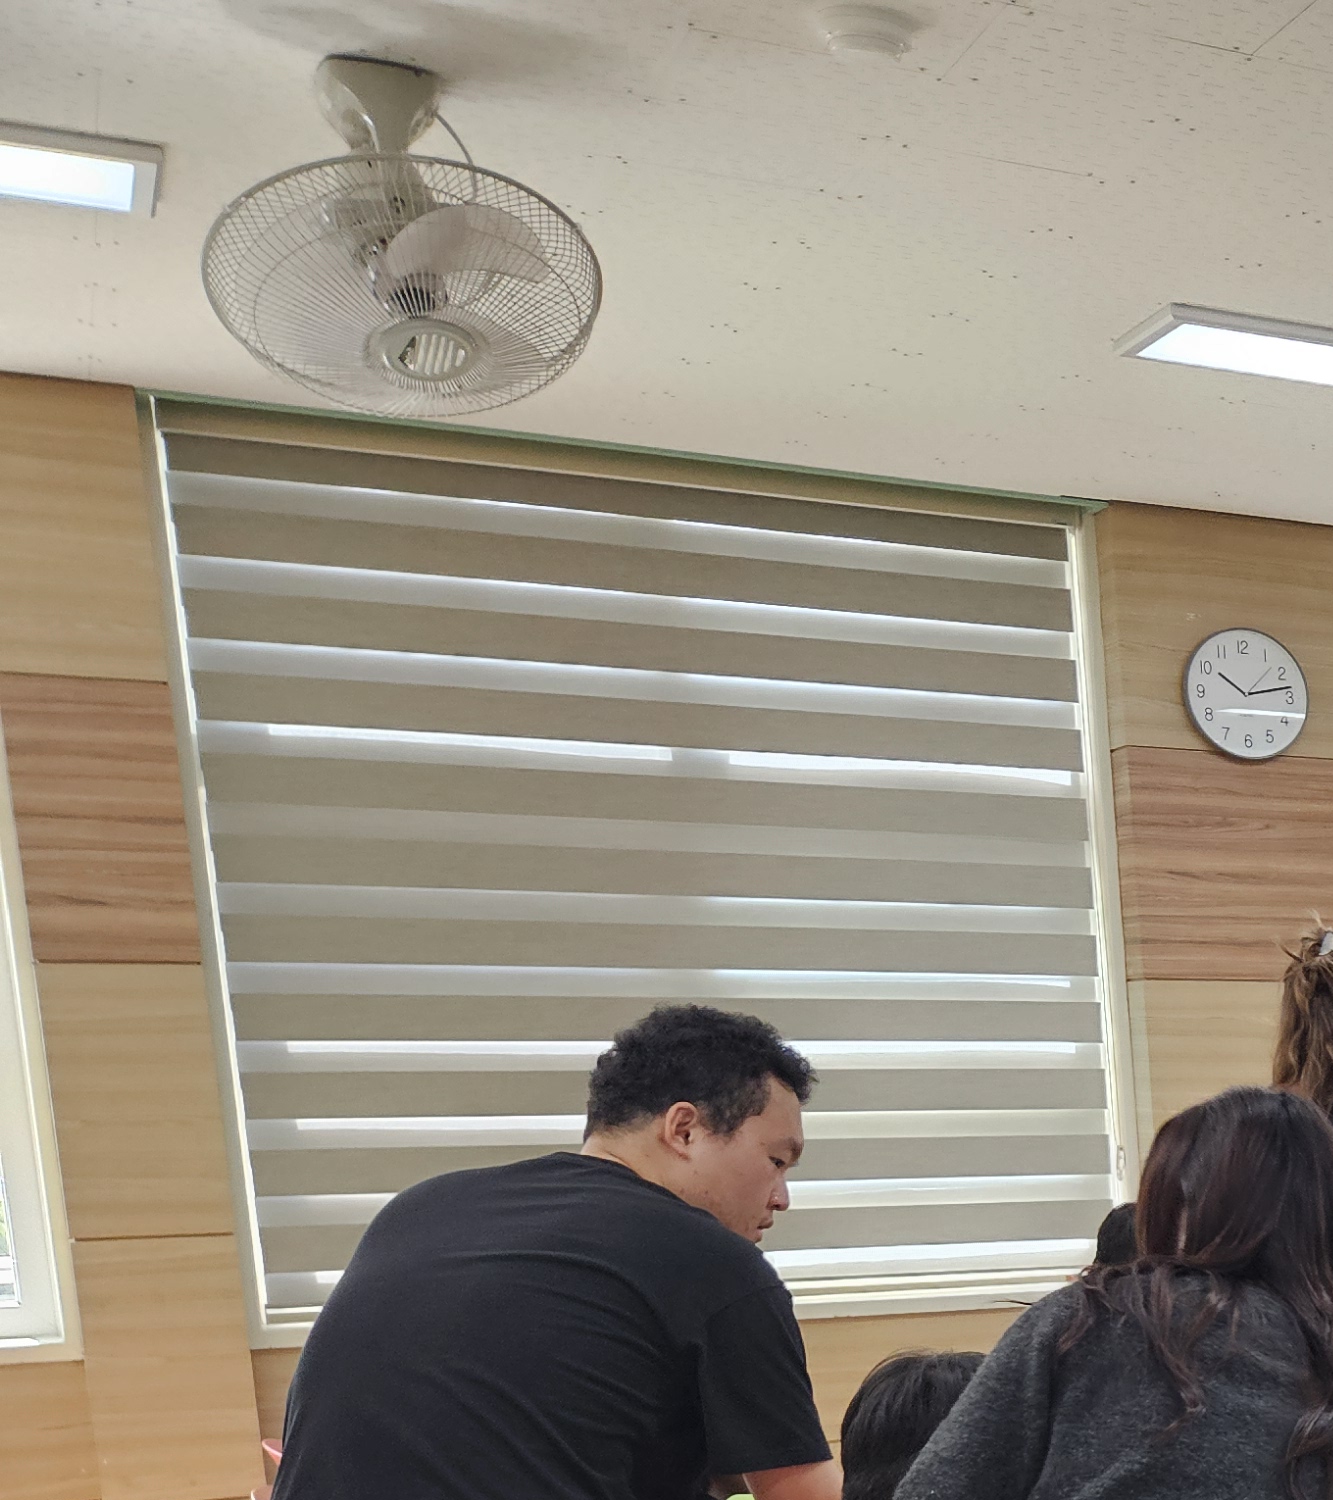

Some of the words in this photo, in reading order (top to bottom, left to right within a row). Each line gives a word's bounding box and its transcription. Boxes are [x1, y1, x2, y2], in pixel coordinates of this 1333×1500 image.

[1216, 644, 1226, 659] 11
[1236, 639, 1249, 655] 12
[1200, 659, 1212, 675] 10
[1277, 666, 1287, 681] 2
[1196, 683, 1205, 698] 9
[1285, 690, 1295, 705] 3
[1204, 707, 1213, 721] 8
[1280, 715, 1289, 726] 4
[1221, 726, 1230, 741] 7
[1244, 733, 1253, 748] 6
[1265, 729, 1275, 743] 5
